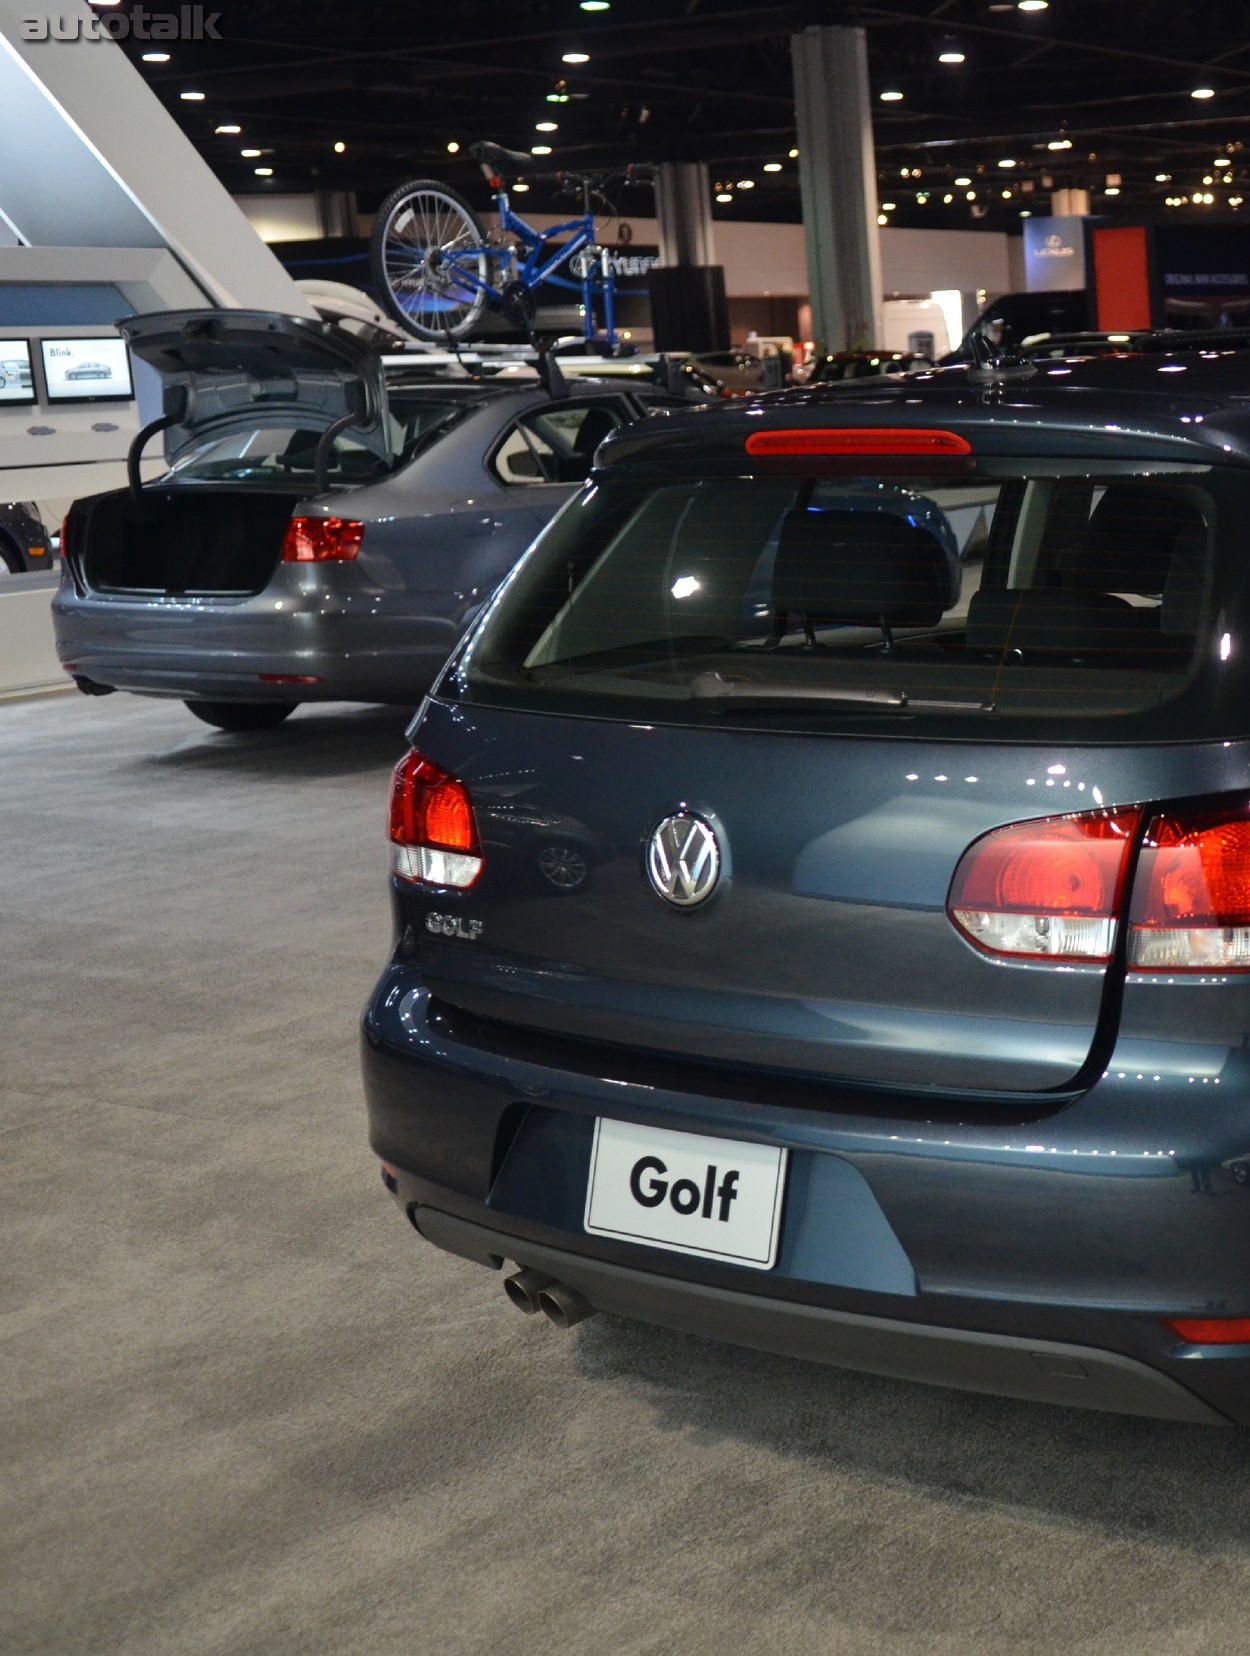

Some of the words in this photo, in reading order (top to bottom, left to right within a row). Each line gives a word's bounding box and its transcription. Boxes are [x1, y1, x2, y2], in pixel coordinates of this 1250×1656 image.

[49, 347, 75, 358] Blink.
[425, 911, 483, 940] GOLF
[629, 1155, 740, 1223] Golf
